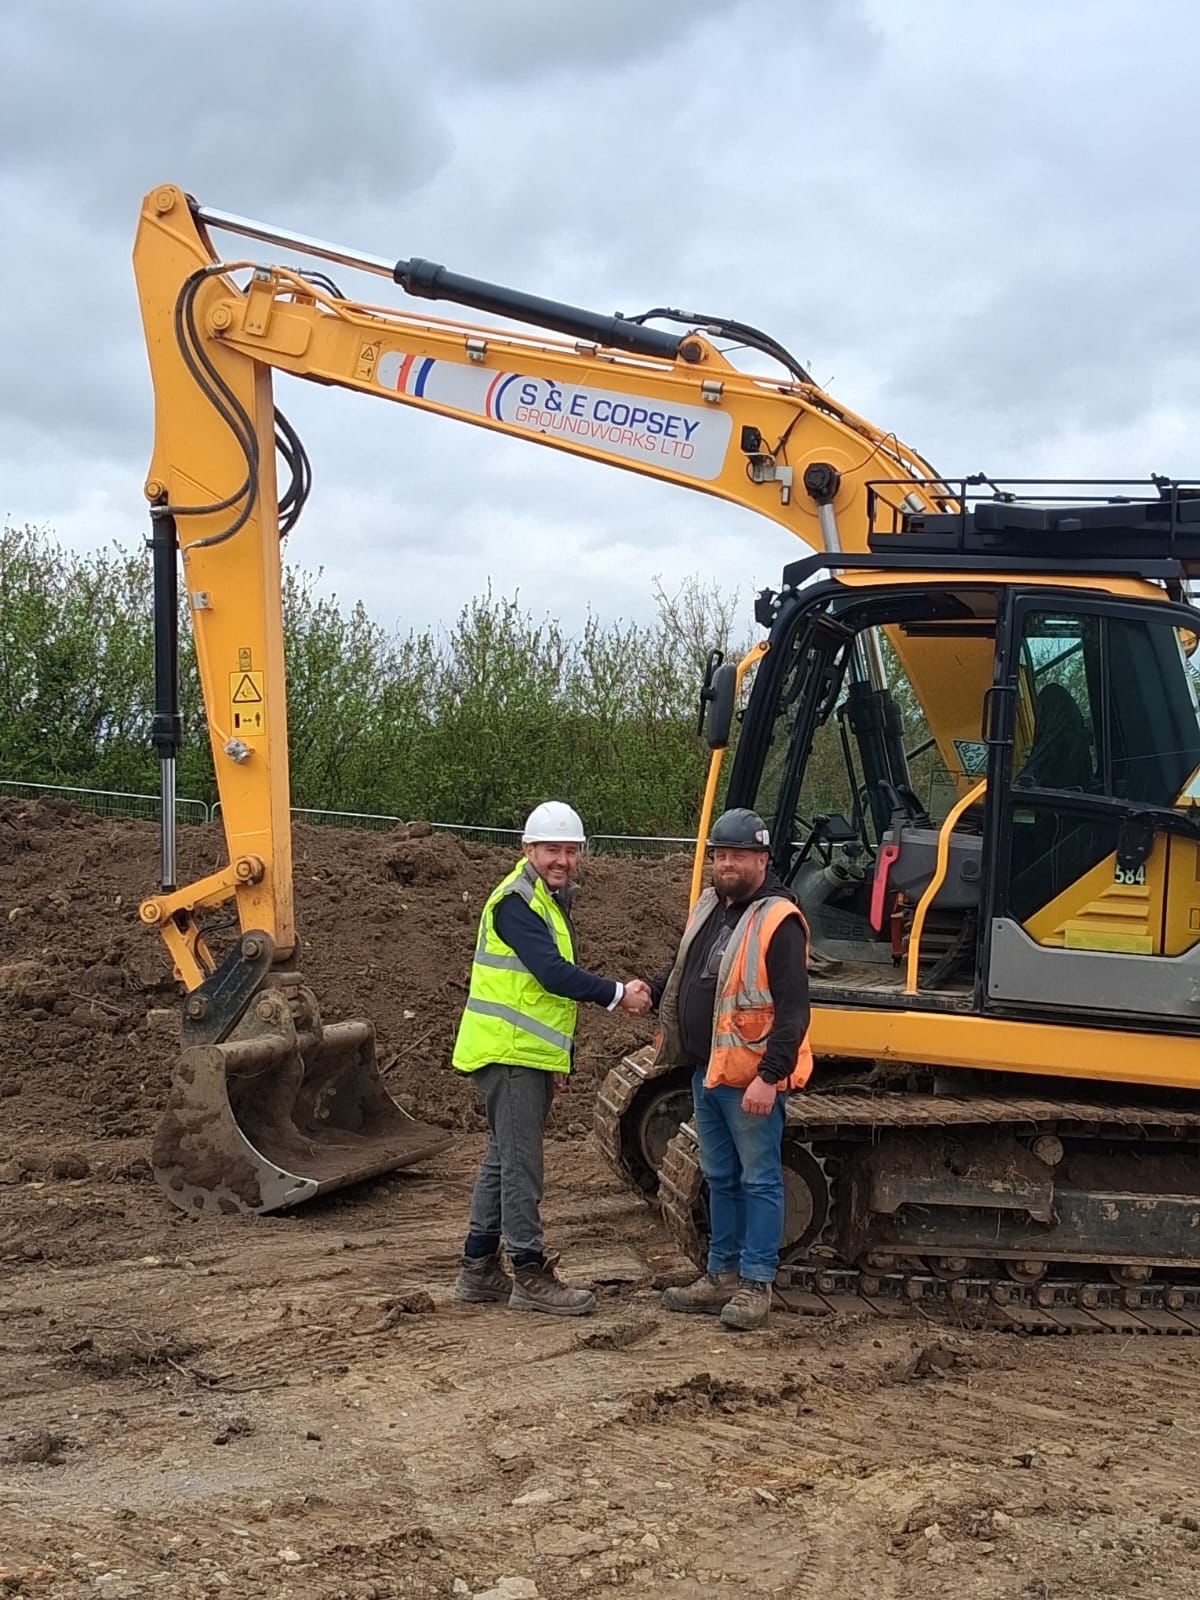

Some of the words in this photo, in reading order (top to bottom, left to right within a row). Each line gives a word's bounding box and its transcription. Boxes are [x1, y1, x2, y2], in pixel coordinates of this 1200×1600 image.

[515, 406, 657, 451] GROUNDWORKS
[660, 439, 695, 460] LTD
[520, 383, 538, 406] S
[544, 387, 562, 412] &
[569, 393, 588, 417] E
[593, 400, 700, 441] COPSEY
[1114, 864, 1145, 885] 584
